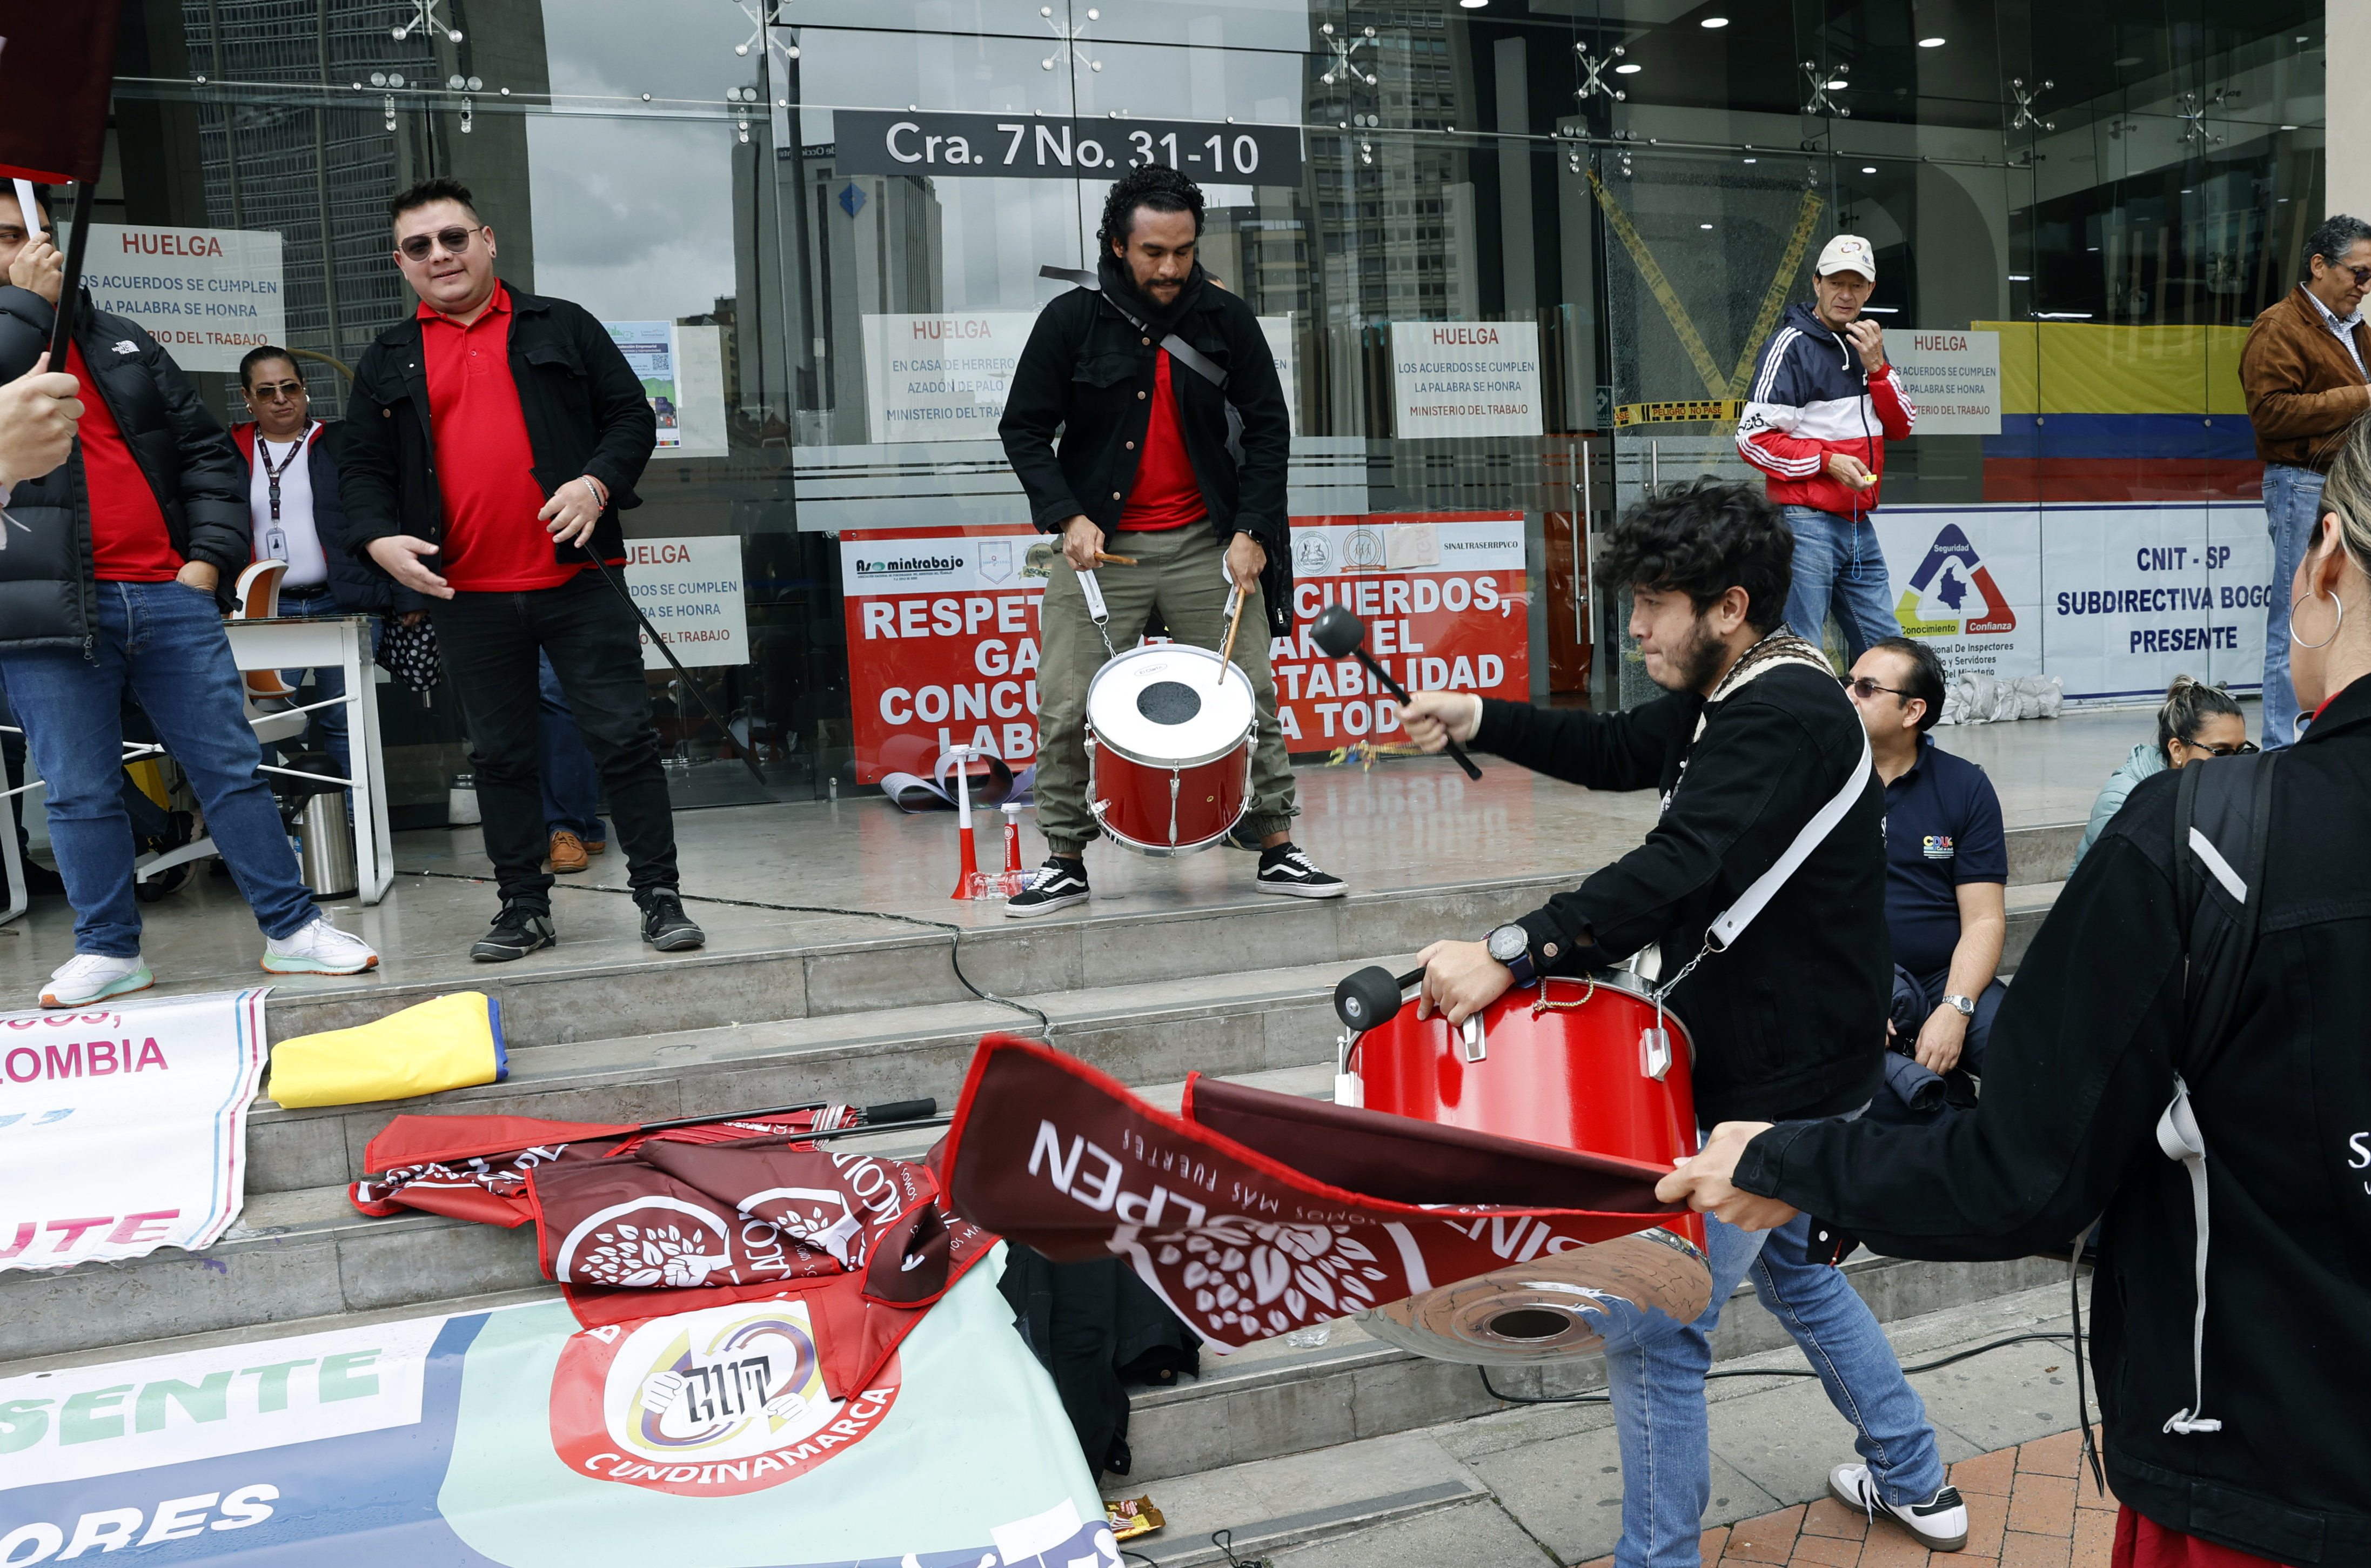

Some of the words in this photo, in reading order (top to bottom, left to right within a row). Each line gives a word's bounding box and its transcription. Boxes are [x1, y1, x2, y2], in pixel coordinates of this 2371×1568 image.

[886, 122, 983, 164] Cra.
[997, 124, 1025, 165] 7
[1035, 125, 1115, 168] No.
[1128, 130, 1259, 174] 31-10
[122, 233, 223, 257] HUELGA
[79, 275, 99, 287] OS
[103, 276, 183, 290] ACUERDOS
[187, 279, 204, 291] SE
[208, 279, 277, 293] CUMPLEN
[96, 300, 113, 312] LA
[117, 300, 180, 314] PALABRA
[184, 303, 202, 315] SE
[206, 304, 257, 317] HONRA
[913, 320, 992, 339] HUELGA
[1433, 328, 1499, 345] HUELGA
[148, 330, 172, 343] RIO
[176, 331, 203, 344] DEL
[206, 332, 268, 346] TRABAJO
[1914, 336, 1967, 351] HUELGA
[893, 360, 908, 371] EN
[911, 360, 942, 371] CASA
[945, 359, 959, 370] DE
[962, 358, 1015, 370] HERRERO
[1274, 359, 1287, 369] EN
[1398, 363, 1417, 373] LOS
[1419, 363, 1473, 373] ACUERDOS
[1475, 362, 1486, 372] SE
[1489, 361, 1534, 372] CUMPLEN
[1903, 367, 1946, 376] ACUERDOS
[1948, 367, 1957, 376] SE
[1959, 367, 1996, 377] CUMPLEN
[908, 379, 955, 393] AZADÓN
[958, 381, 973, 392] DE
[976, 380, 1004, 392] PALO
[1415, 383, 1426, 392] LA
[1429, 381, 1471, 392] PALABRA
[1473, 381, 1485, 392] SE
[1488, 381, 1522, 391] HONRA
[1910, 384, 1944, 394] PALABRA
[1946, 384, 1955, 394] SE
[1957, 384, 1985, 394] HONRA
[887, 407, 953, 421] MINISTERIO
[956, 407, 977, 418] DEL
[1410, 405, 1465, 416] MINISTERIO
[1468, 405, 1485, 415] DEL
[1488, 404, 1528, 415] TRABAJO
[1616, 411, 1630, 420] ASE
[1653, 407, 1686, 417] PELIGRO
[1690, 406, 1702, 415] NO
[1704, 406, 1723, 414] PASE
[1917, 405, 1939, 414] TERIO
[1941, 405, 1955, 415] DEL
[1957, 405, 1990, 415] TRABAJO
[626, 544, 691, 565] UELGA
[1934, 544, 1969, 553] Seguridad
[2136, 547, 2187, 571] CNIT
[2206, 546, 2231, 569] SP
[628, 584, 658, 597] DOS
[660, 584, 675, 595] SE
[678, 581, 737, 594] CUMPLEN
[1294, 577, 1511, 619] CUERDOS,
[2057, 587, 2213, 615] SUBDIRECTIVA
[640, 606, 656, 618] RA
[659, 606, 673, 617] SE
[677, 604, 721, 617] HONRA
[1901, 624, 1956, 634] Conocimiento
[1970, 622, 2012, 631] Confianza
[653, 633, 675, 644] EL
[677, 629, 730, 642] TRABAJO
[2131, 626, 2238, 654] PRESENTE
[975, 638, 1040, 676] GA
[1372, 619, 1423, 655] EL
[1930, 644, 1953, 654] cional
[1955, 644, 1965, 653] De
[1968, 643, 2014, 654] Inspectores
[1948, 659, 1953, 667] y
[1955, 655, 1996, 666] Servidores
[938, 723, 1041, 762] LAB
[1314, 699, 1401, 738] TOD
[0, 1037, 168, 1084] OMBIA
[1123, 1129, 1217, 1192] FUERTES
[1028, 1119, 1207, 1228] LPEN
[901, 1167, 917, 1201] SOMOS
[950, 1237, 964, 1251] OS
[963, 1223, 982, 1239] MÁ
[0, 1348, 383, 1454] SENTE
[585, 1386, 894, 1484] CUNDINAMARCA
[0, 1483, 280, 1568] ORES
